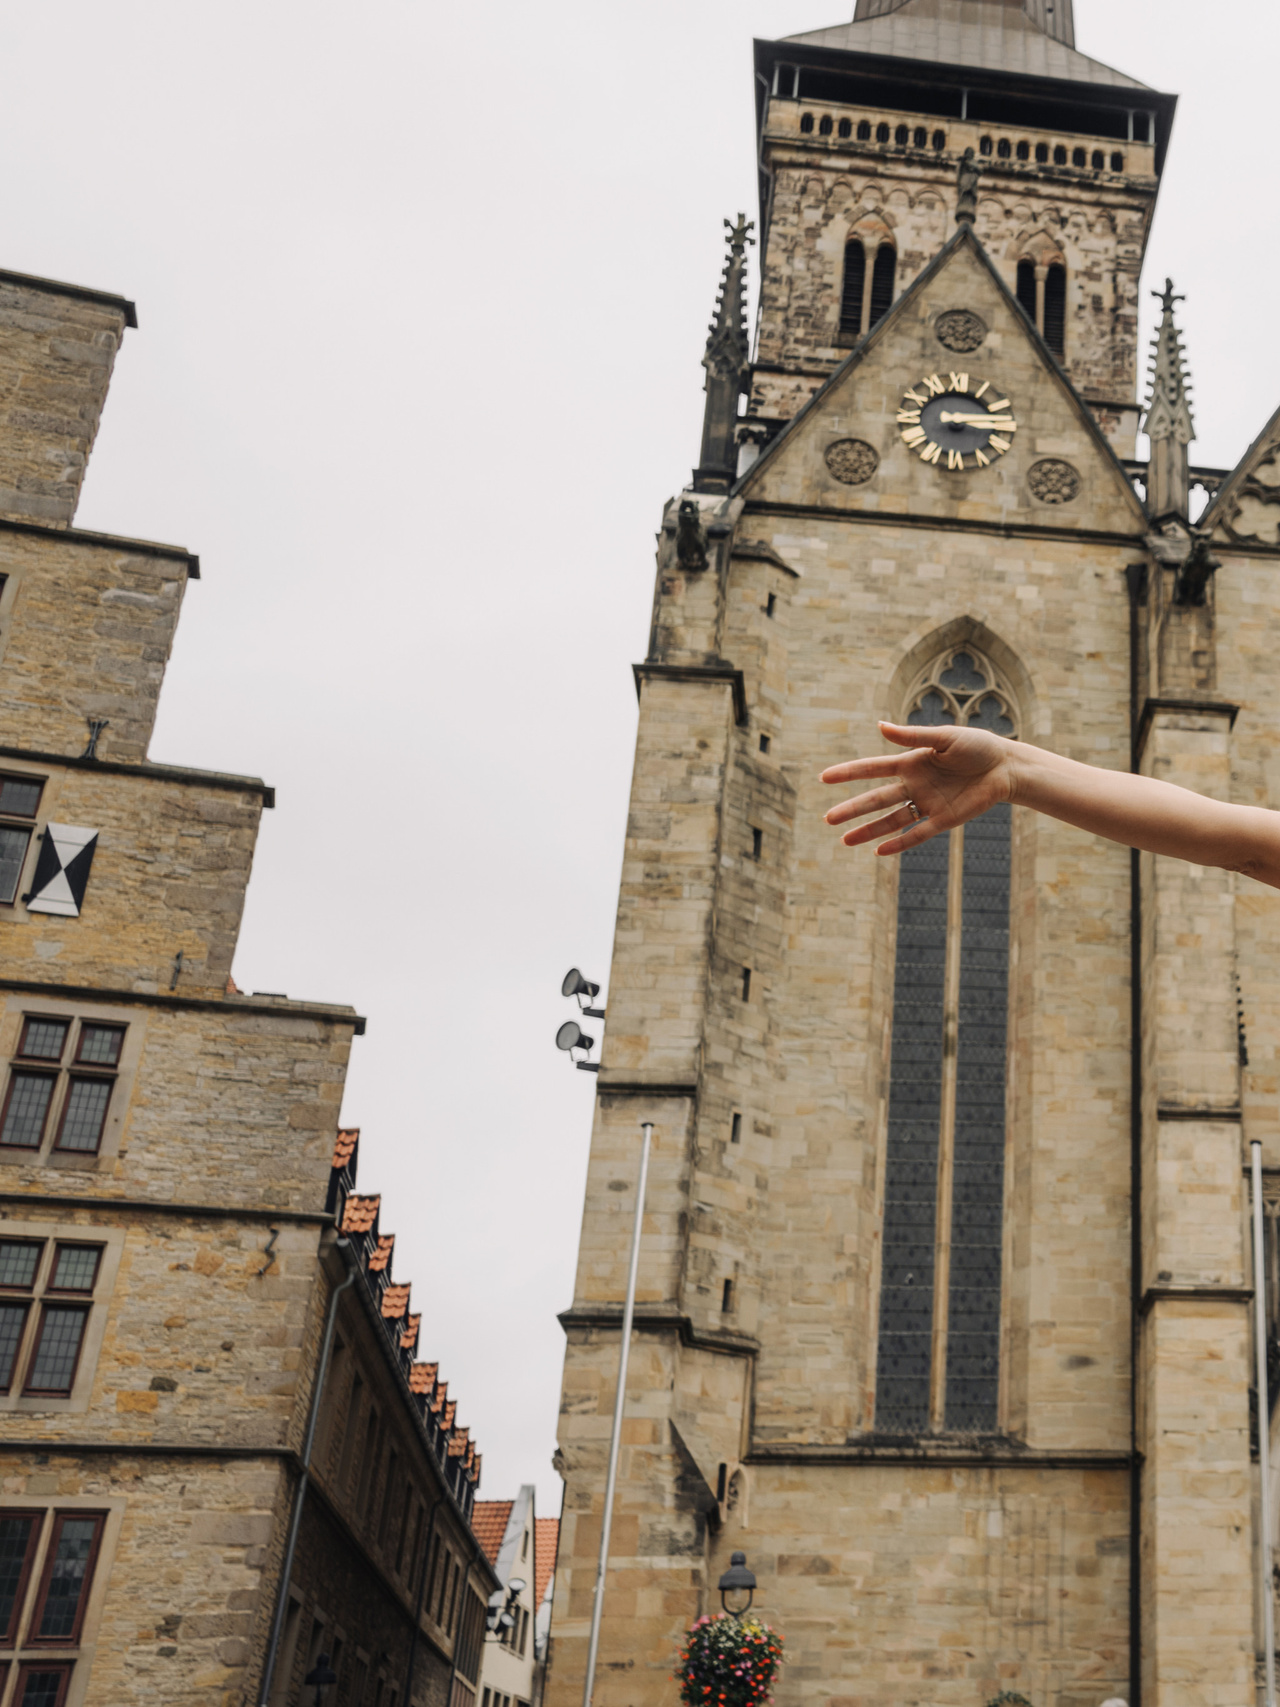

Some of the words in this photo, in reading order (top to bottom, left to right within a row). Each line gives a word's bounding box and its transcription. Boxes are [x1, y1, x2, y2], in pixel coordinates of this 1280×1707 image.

[922, 373, 945, 397] XI
[948, 371, 969, 393] XII
[975, 381, 990, 398] I
[903, 387, 928, 407] X
[987, 398, 1011, 412] II
[896, 408, 921, 424] IX
[948, 449, 964, 470] VI
[975, 448, 990, 467] V
